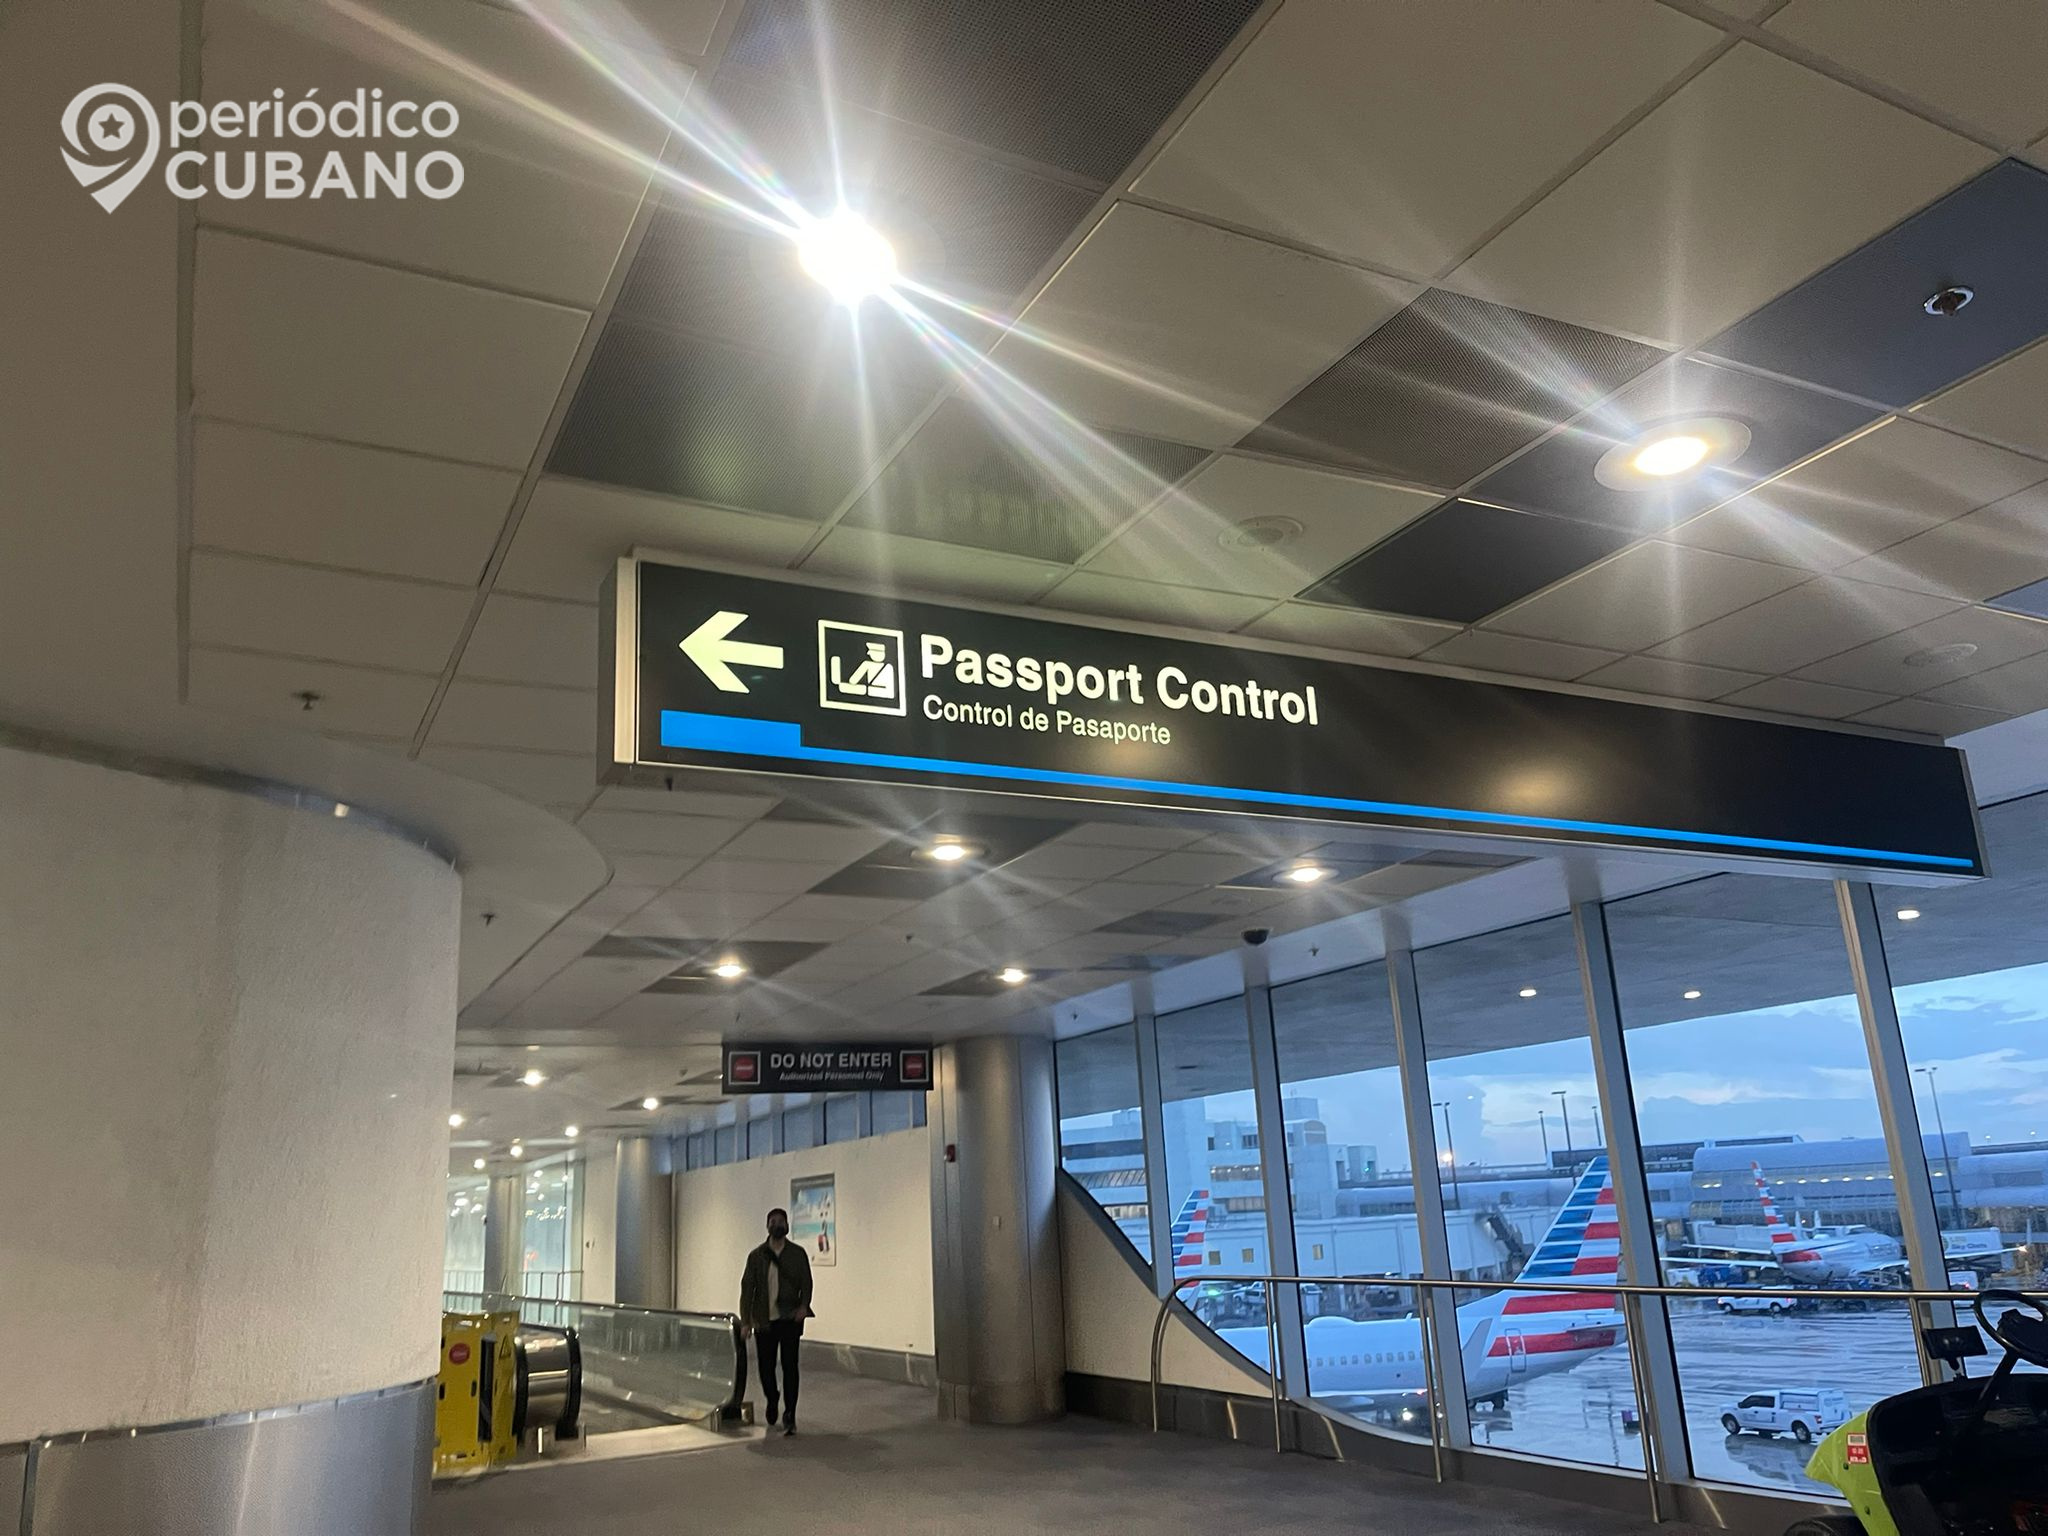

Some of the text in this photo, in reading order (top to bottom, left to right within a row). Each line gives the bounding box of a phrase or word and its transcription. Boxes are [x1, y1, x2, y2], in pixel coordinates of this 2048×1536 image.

[920, 634, 1319, 726] Passport Control
[922, 695, 1171, 745] Control de Pasaporte
[770, 1052, 892, 1068] DO NOT ENTER
[865, 1070, 885, 1082] Only
